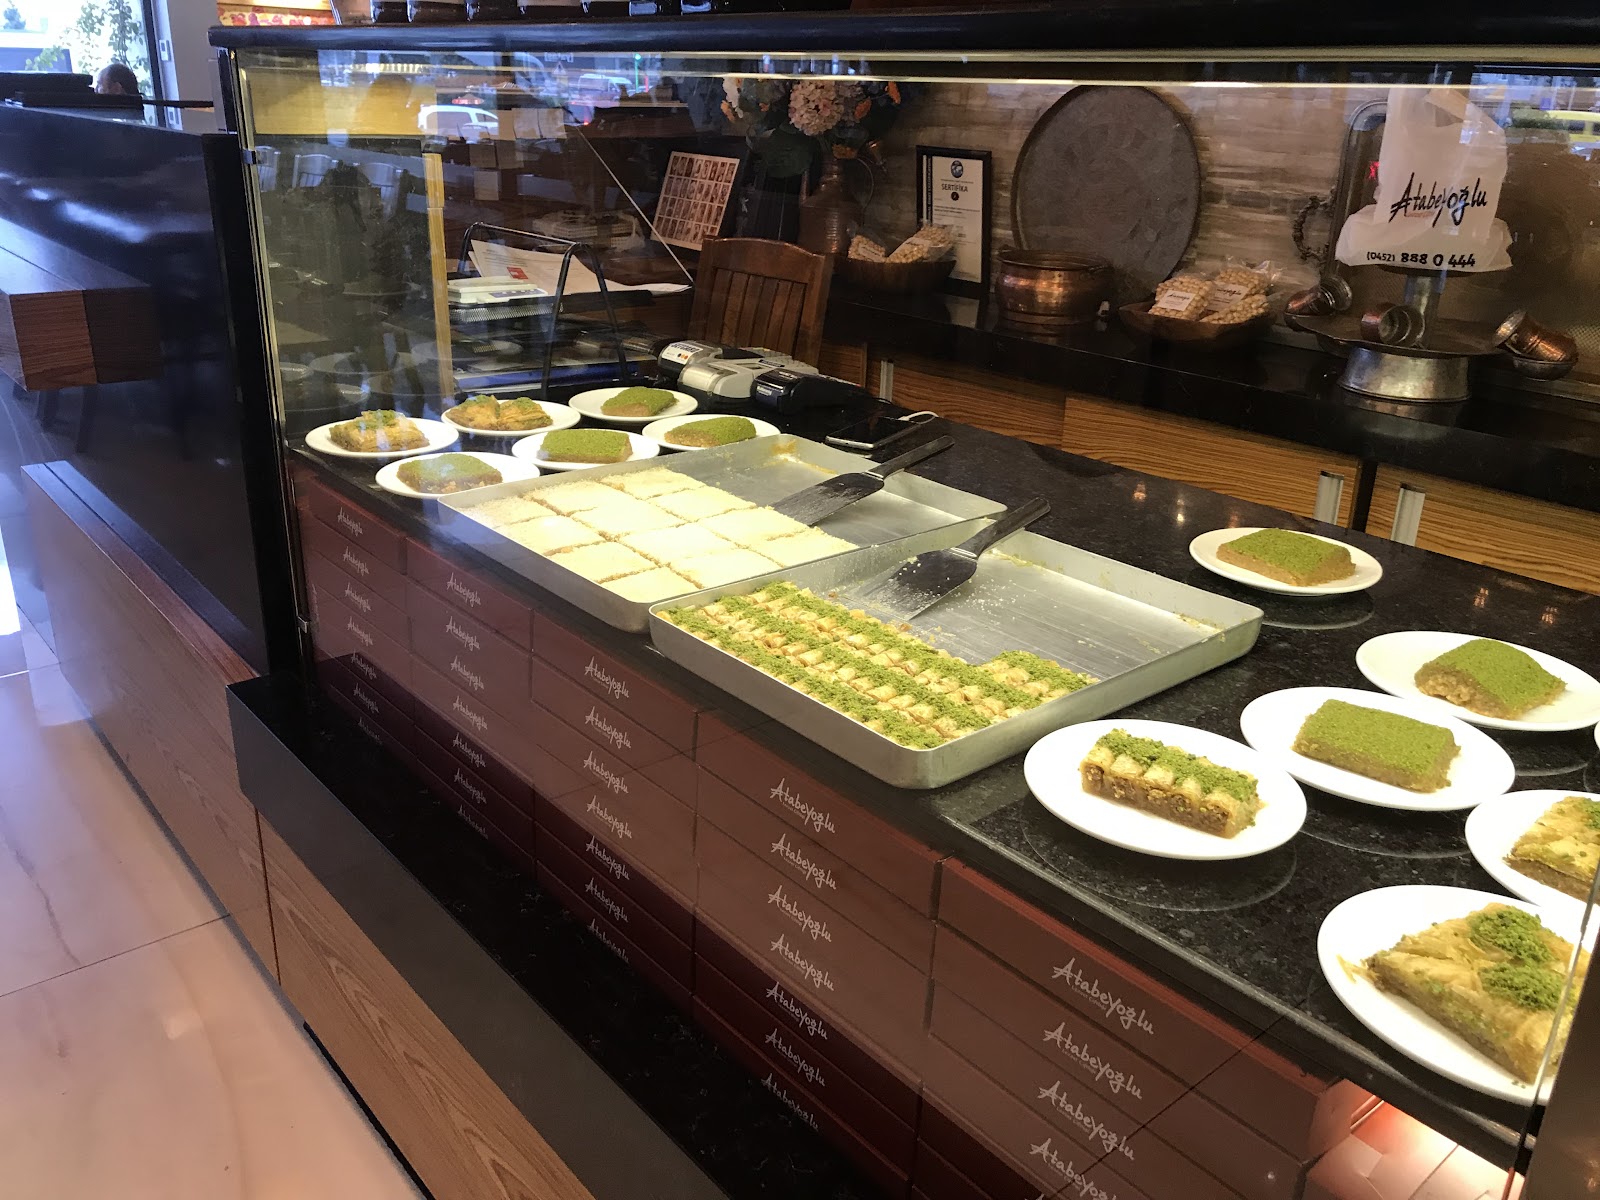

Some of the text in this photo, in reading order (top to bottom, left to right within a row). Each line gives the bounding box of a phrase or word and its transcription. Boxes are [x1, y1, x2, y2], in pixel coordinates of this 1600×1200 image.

[1366, 251, 1476, 268] (0452) 888 0 444
